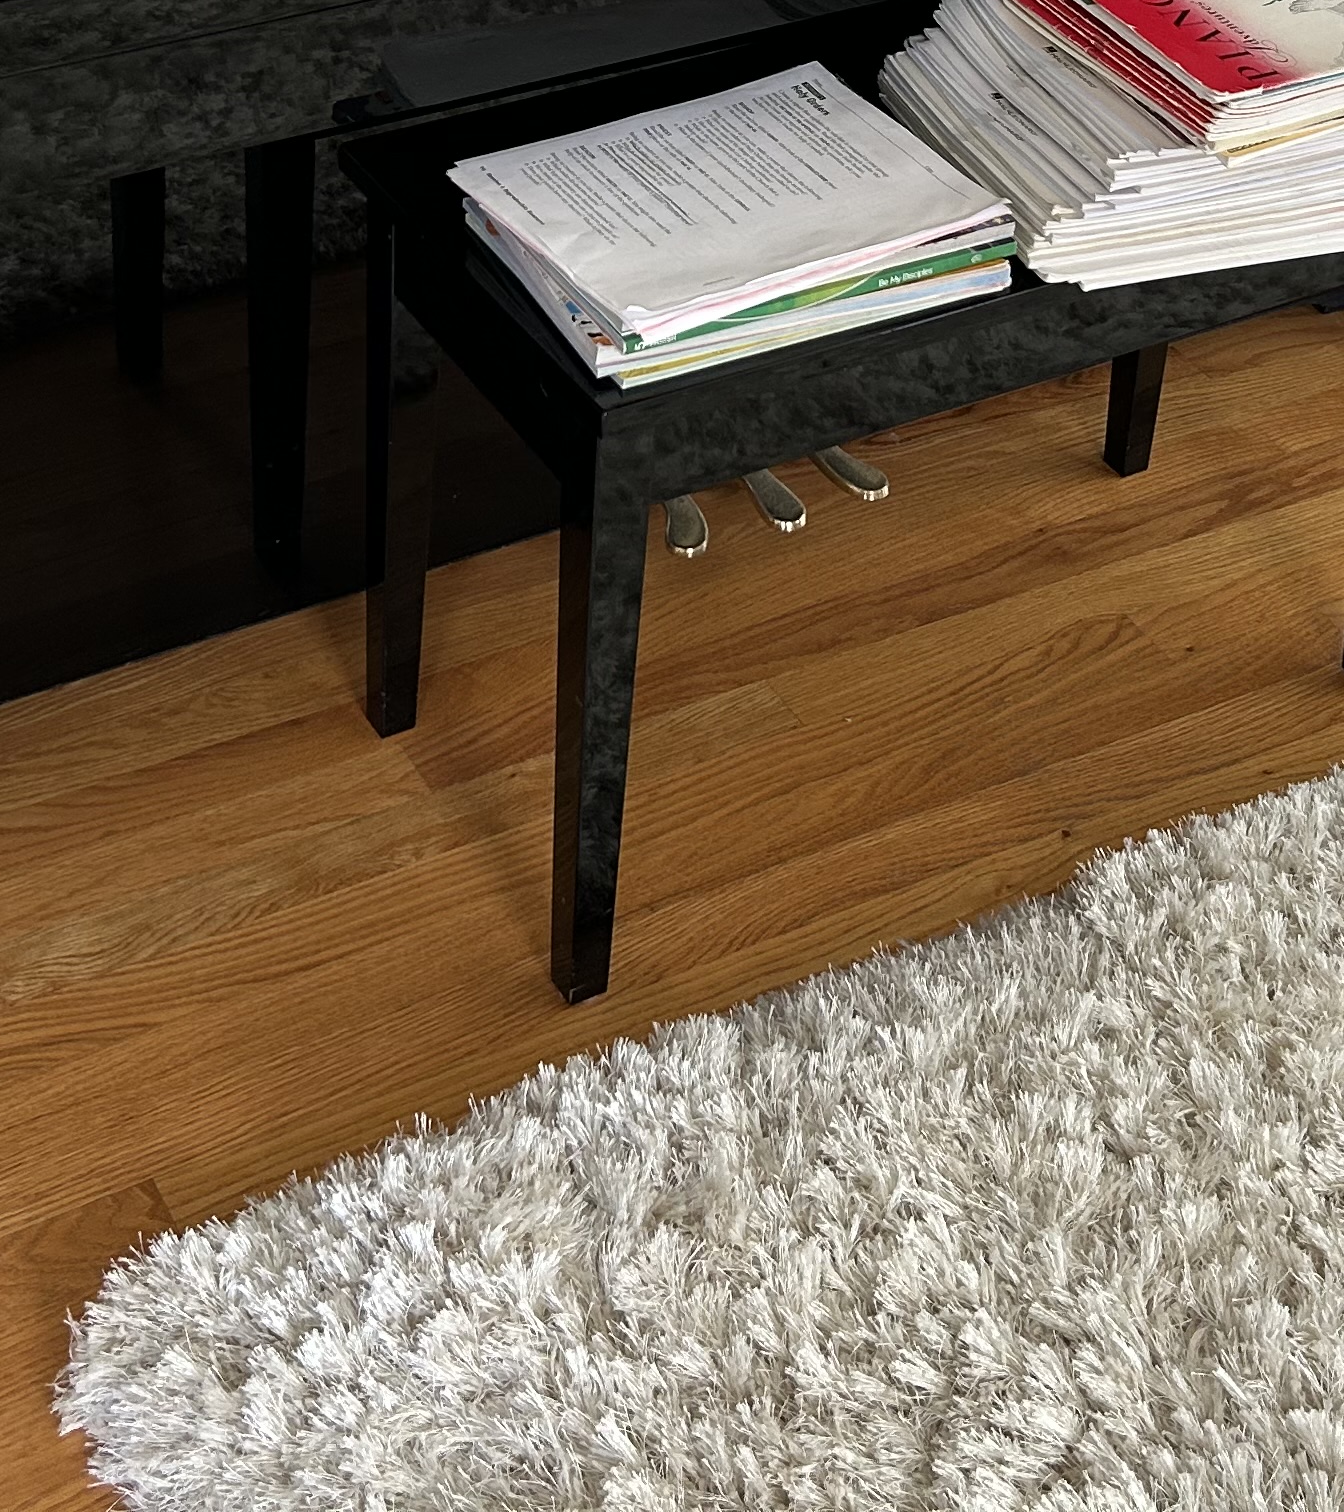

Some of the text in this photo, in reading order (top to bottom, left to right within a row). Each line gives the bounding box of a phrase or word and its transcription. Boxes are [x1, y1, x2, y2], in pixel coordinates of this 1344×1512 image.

[790, 83, 813, 99] Holy
[806, 96, 832, 116] Orders
[878, 268, 933, 287] Be My Disciples
